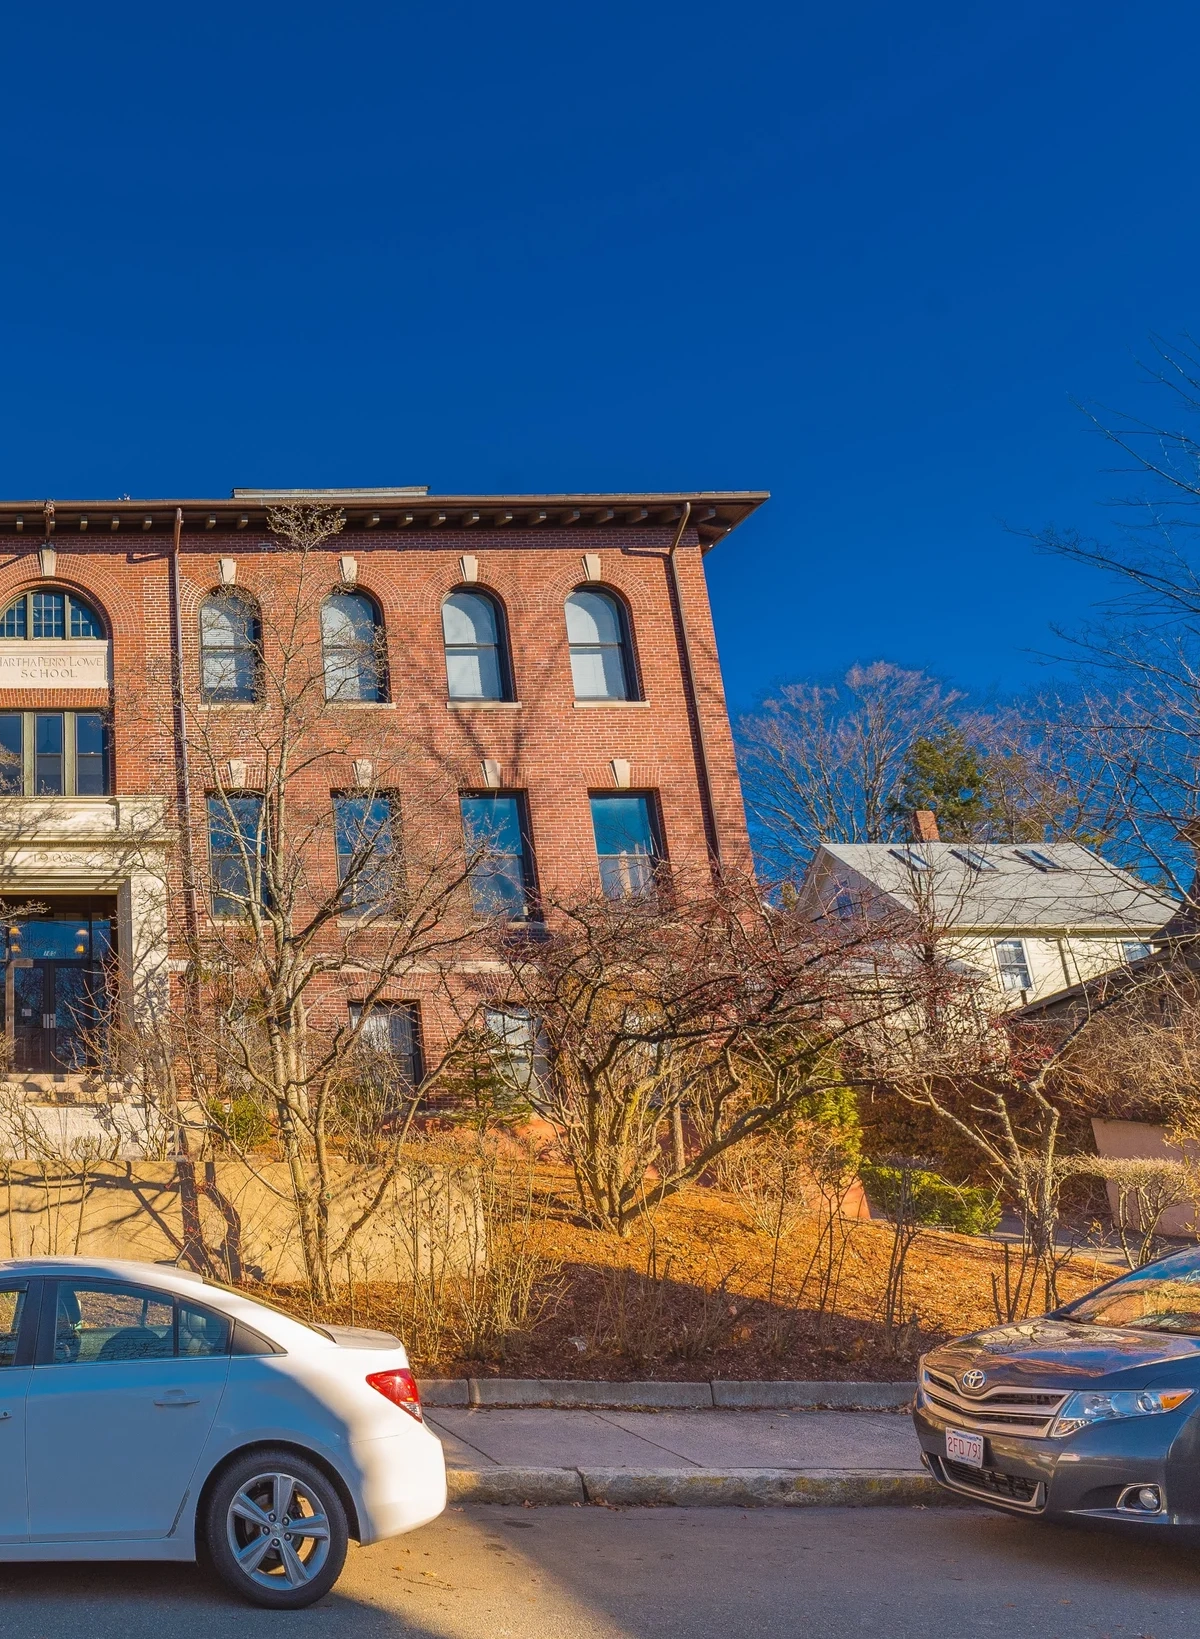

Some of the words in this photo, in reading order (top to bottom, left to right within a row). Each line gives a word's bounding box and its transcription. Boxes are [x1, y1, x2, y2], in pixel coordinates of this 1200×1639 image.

[37, 656, 68, 667] PERRY
[69, 656, 103, 667] LOWE
[21, 669, 78, 678] SCHOOL
